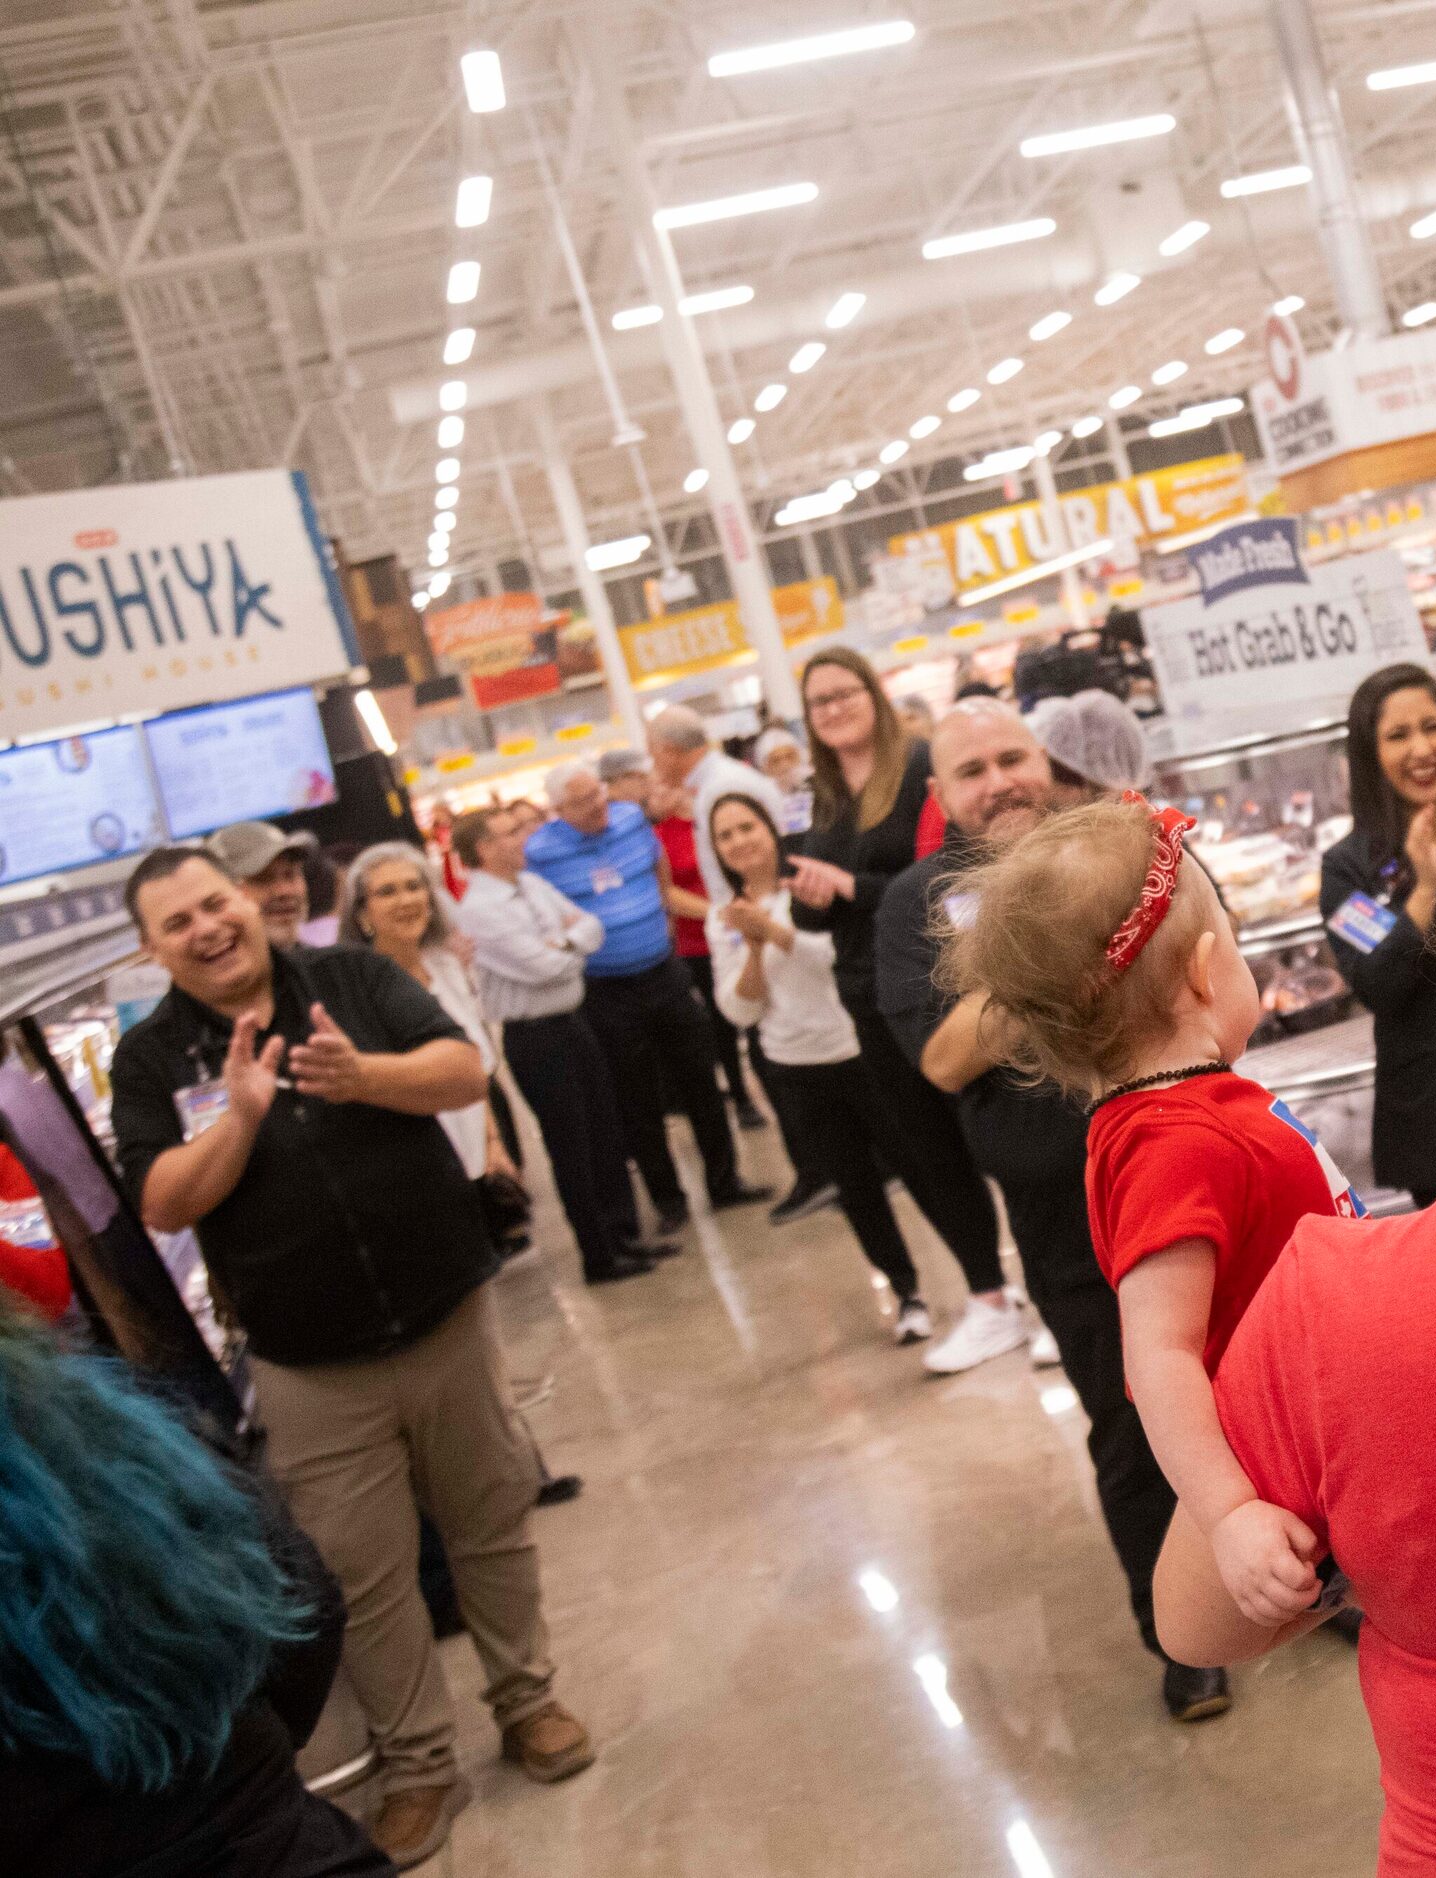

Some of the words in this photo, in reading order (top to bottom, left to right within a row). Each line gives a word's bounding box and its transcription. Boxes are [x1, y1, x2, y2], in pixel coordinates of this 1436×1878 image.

[1188, 628, 1237, 677] Hot
[1235, 611, 1298, 669] Grab
[1294, 604, 1318, 661] &
[1315, 602, 1358, 656] Go
